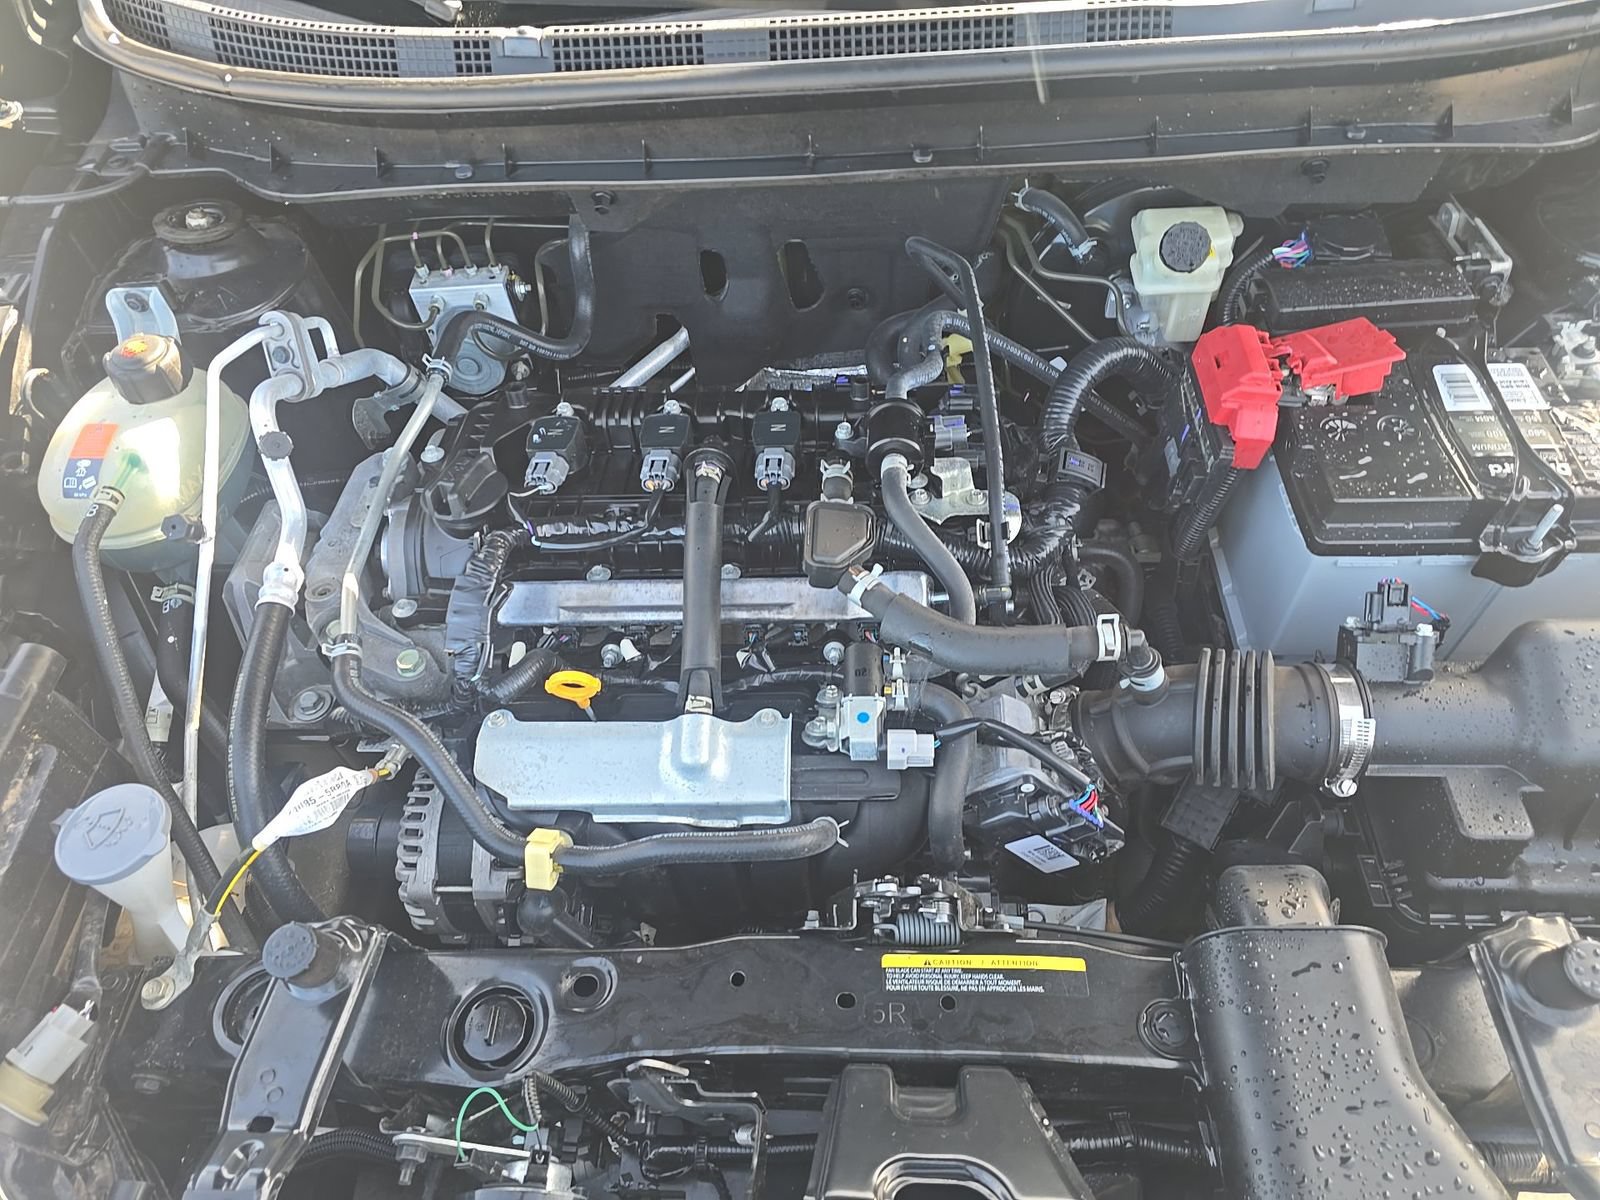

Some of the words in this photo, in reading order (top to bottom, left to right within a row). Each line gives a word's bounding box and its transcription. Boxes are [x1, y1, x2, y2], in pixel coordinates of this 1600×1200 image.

[933, 959, 972, 967] CAUTION
[991, 959, 1038, 967] ATTENTION
[873, 1002, 905, 1024] 5R
